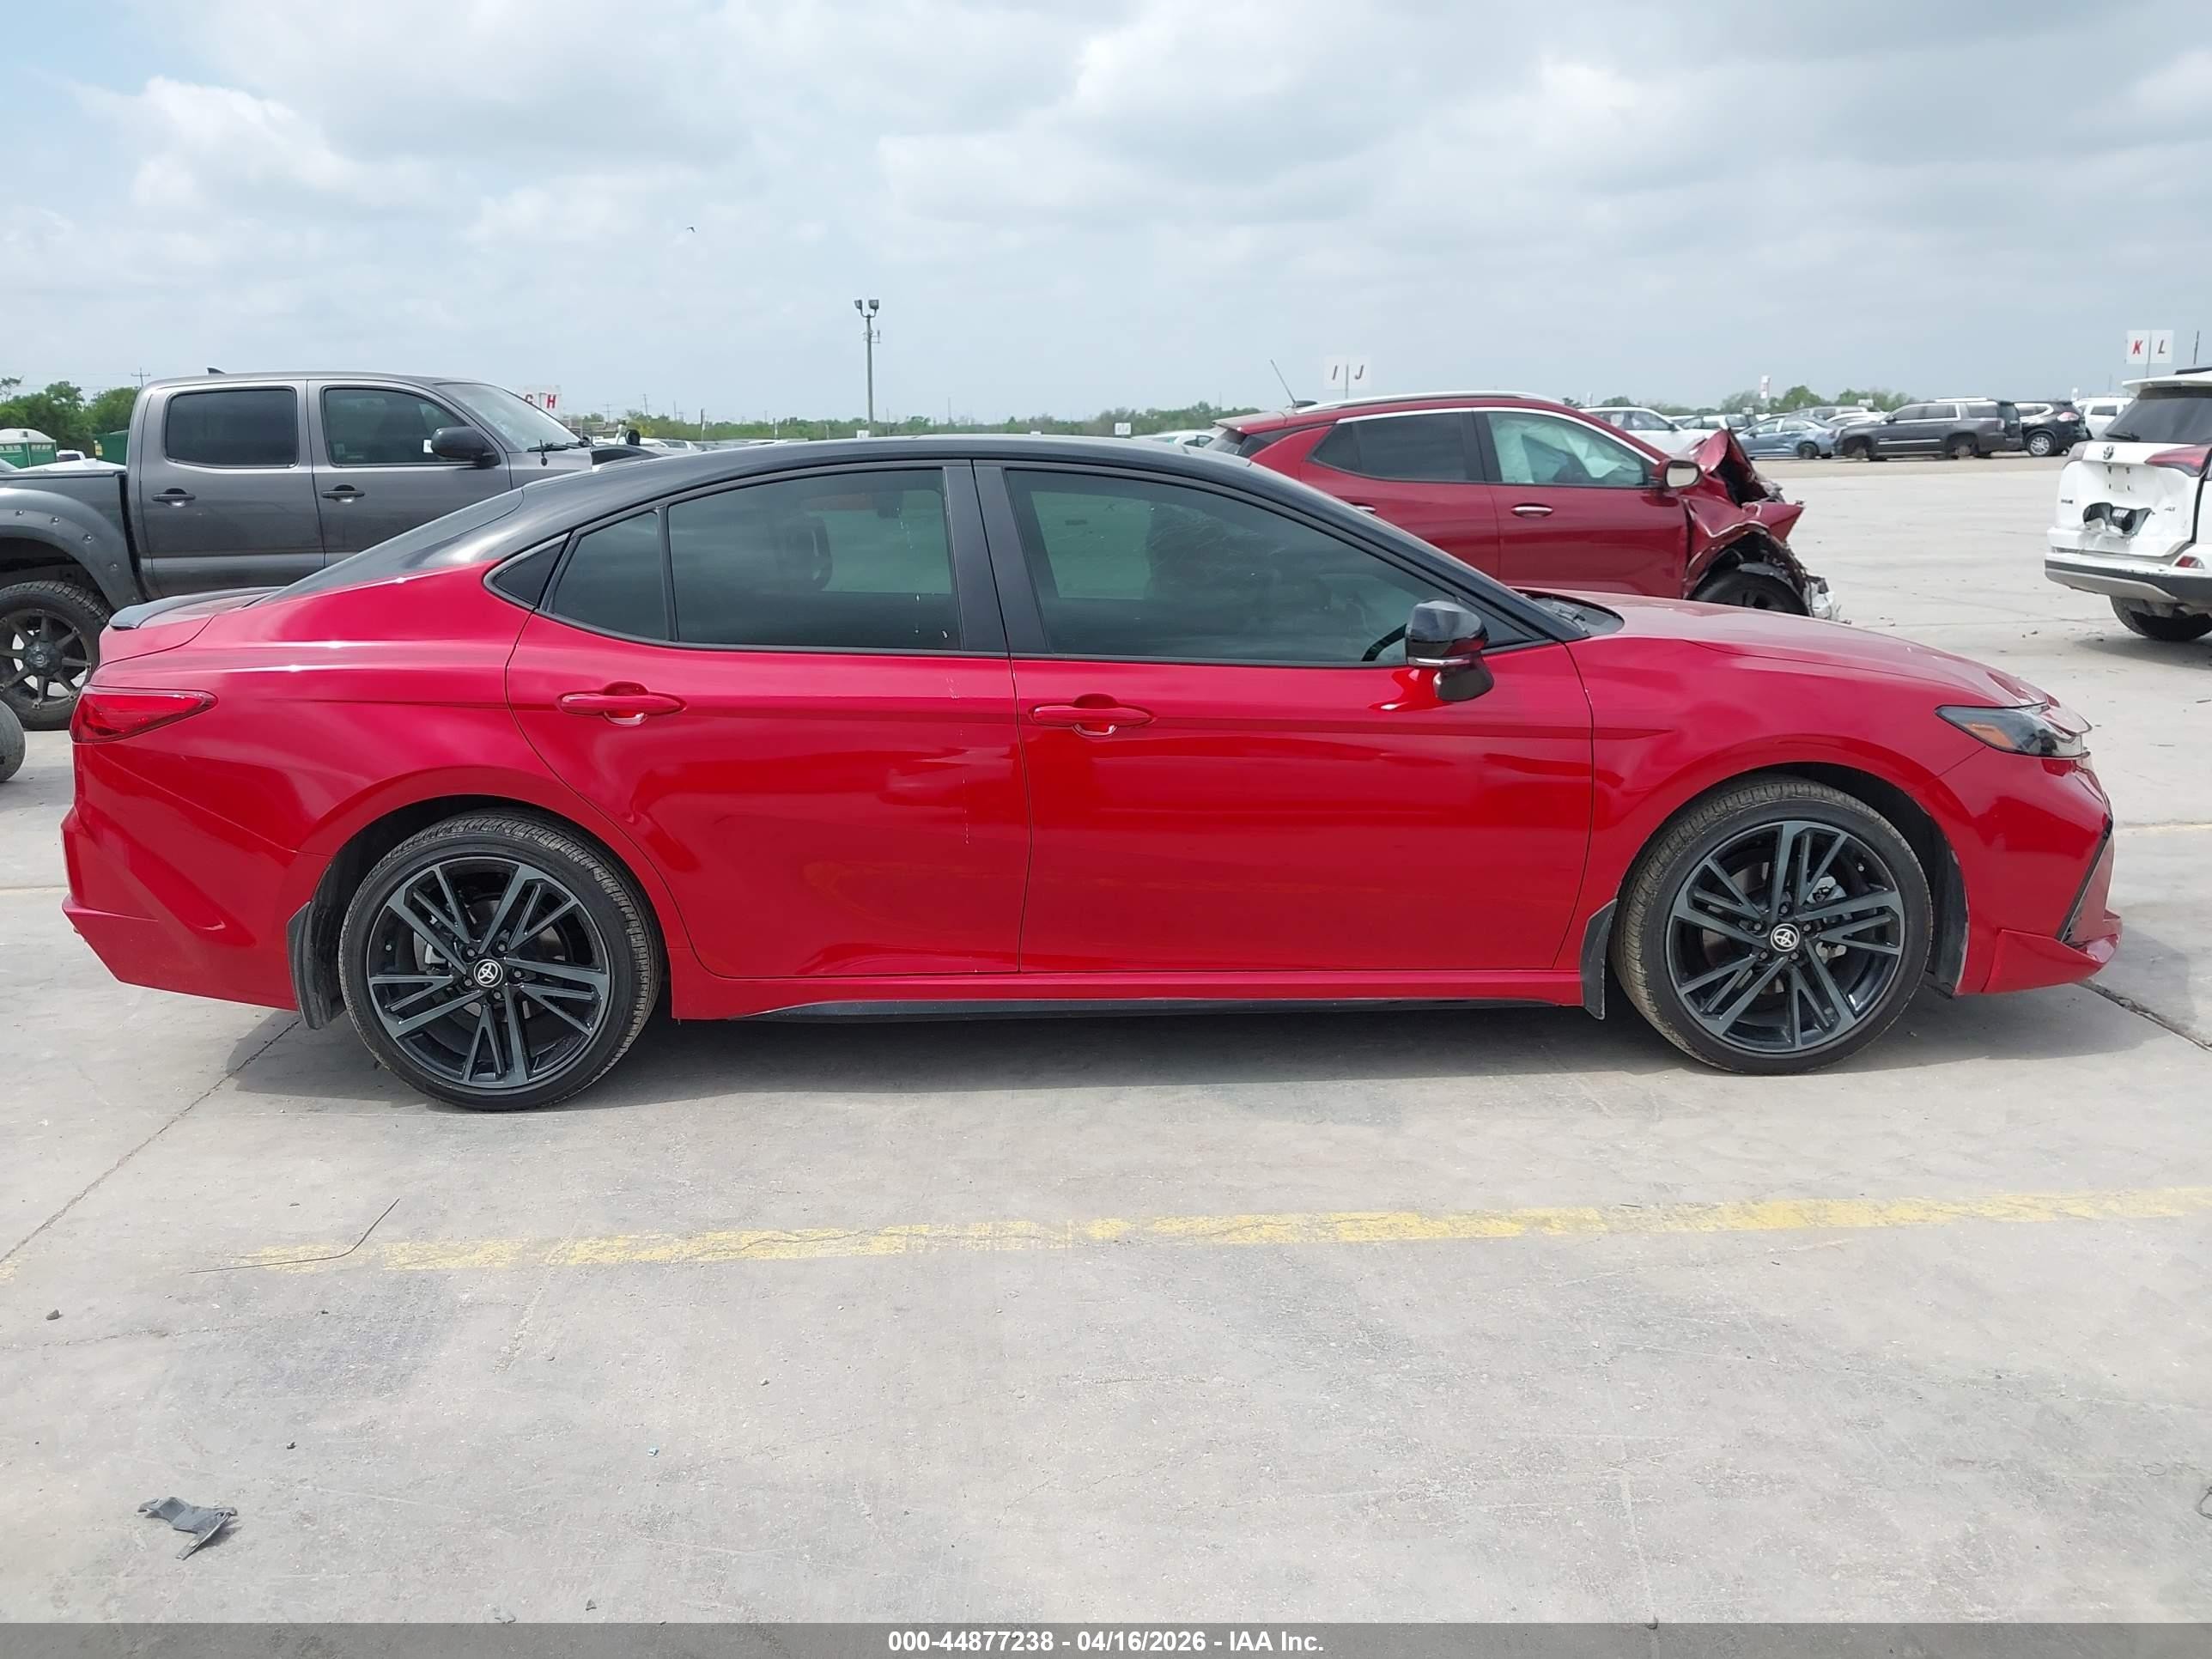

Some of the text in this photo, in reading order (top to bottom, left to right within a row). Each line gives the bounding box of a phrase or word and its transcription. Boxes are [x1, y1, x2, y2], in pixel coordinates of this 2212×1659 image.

[2132, 339, 2166, 355] K L
[1354, 364, 1364, 380] J
[546, 394, 556, 409] H
